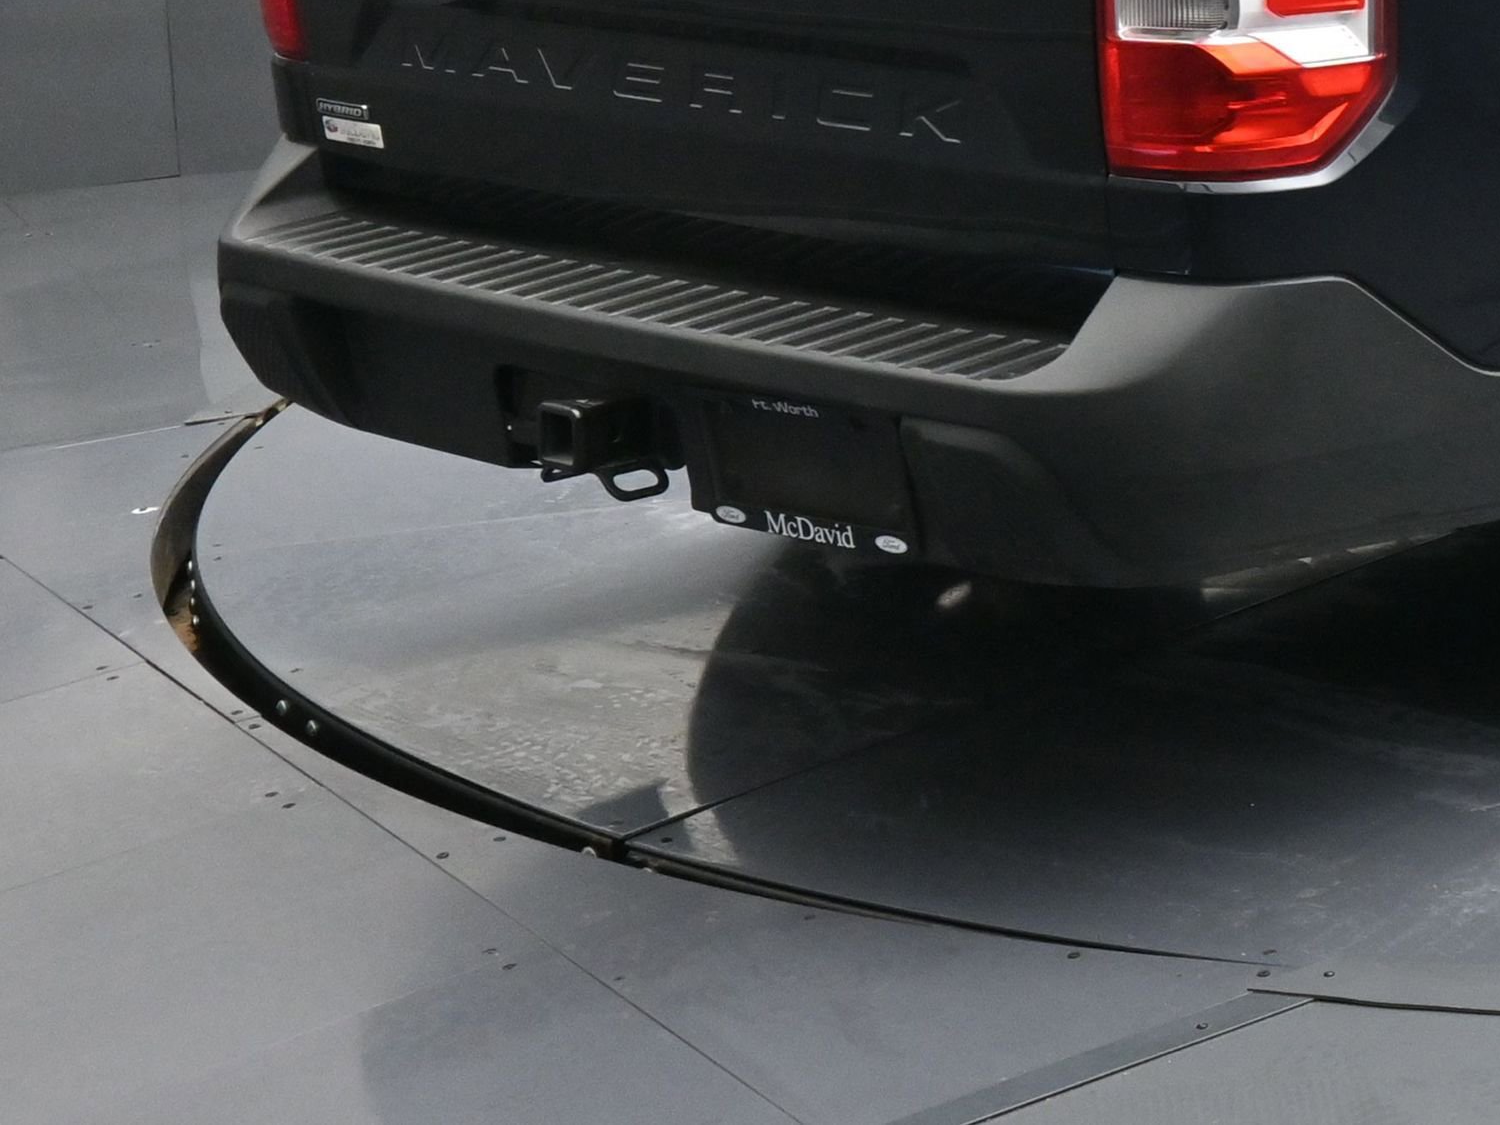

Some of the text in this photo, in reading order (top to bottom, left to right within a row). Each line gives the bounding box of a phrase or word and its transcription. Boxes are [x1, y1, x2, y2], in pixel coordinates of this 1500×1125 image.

[401, 38, 962, 144] MAVERICK
[319, 101, 362, 117] HYBRID
[771, 401, 819, 417] Worth
[764, 510, 856, 549] McDavid
